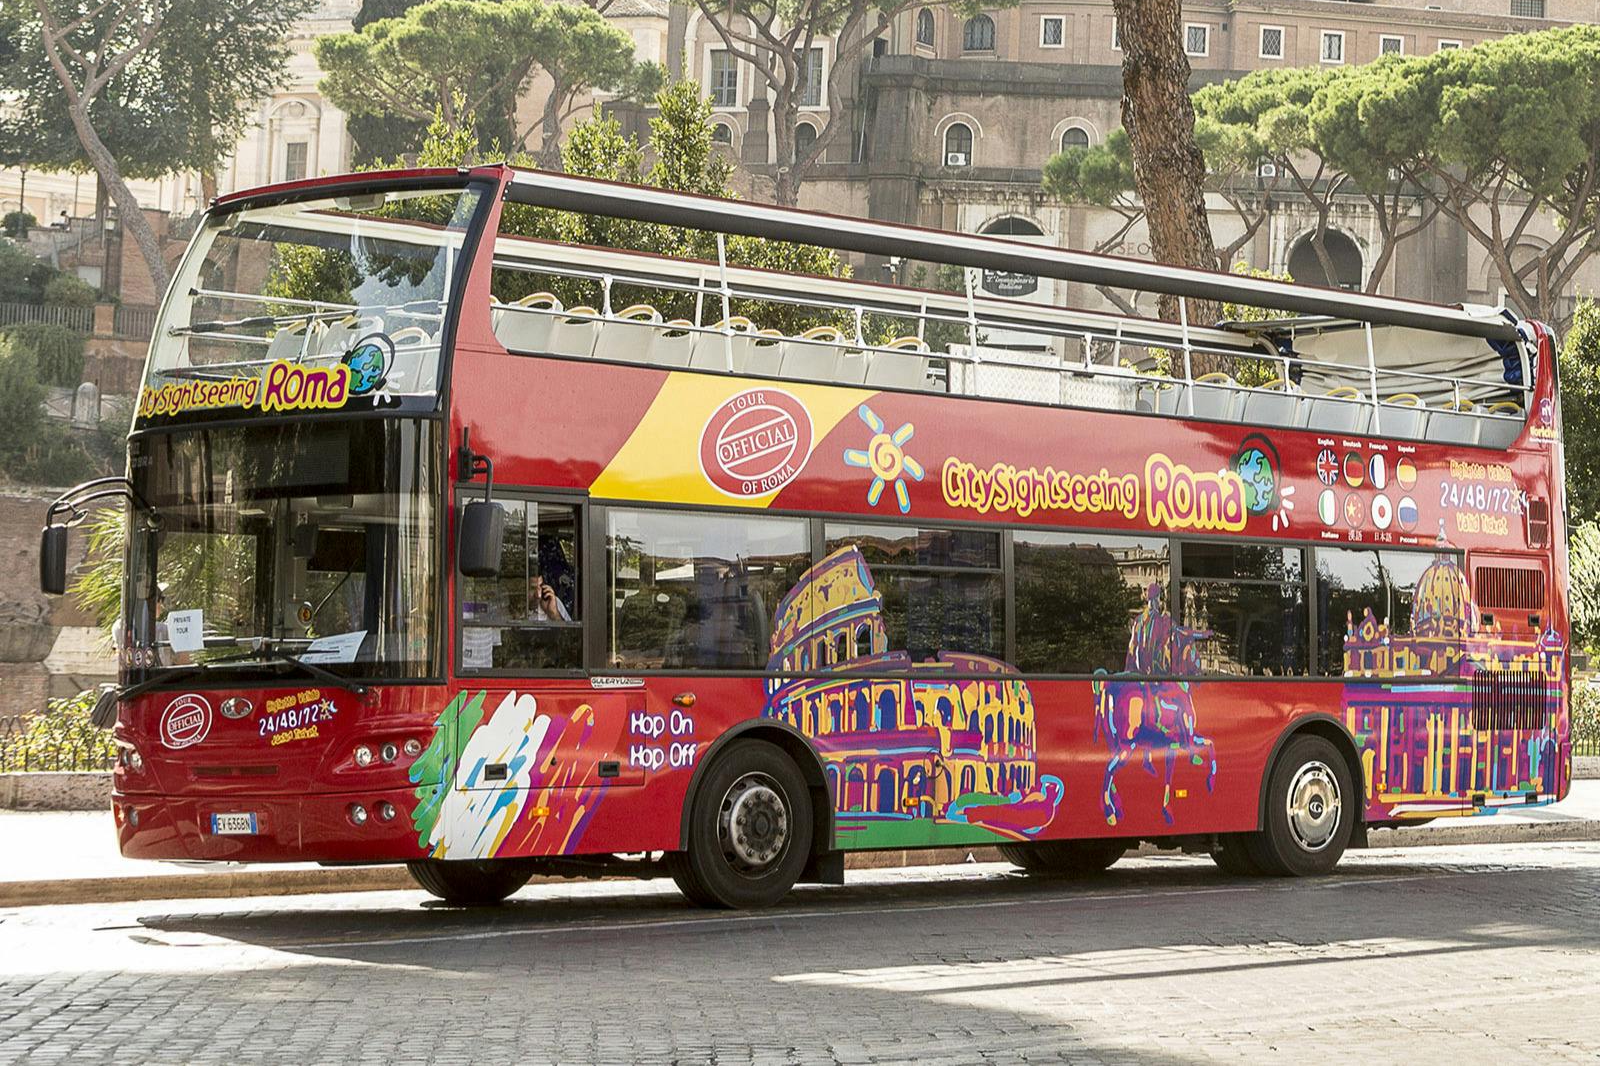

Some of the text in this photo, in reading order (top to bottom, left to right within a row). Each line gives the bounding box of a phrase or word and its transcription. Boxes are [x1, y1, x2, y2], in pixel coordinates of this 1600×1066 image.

[1096, 241, 1150, 256] SEO
[728, 392, 767, 414] TOUR
[719, 423, 795, 463] OFFICIAL
[1317, 437, 1336, 447] English
[1342, 439, 1362, 449] Deutsch
[741, 463, 796, 495] OF ROMA
[1440, 481, 1511, 512] 24/48/72
[1456, 512, 1481, 532] Valid
[1374, 531, 1393, 543] 日本語
[169, 713, 202, 732] OFFICIAL
[259, 704, 319, 736] 24/48/72
[631, 709, 694, 739] Hop On
[630, 742, 697, 771] Hop Off
